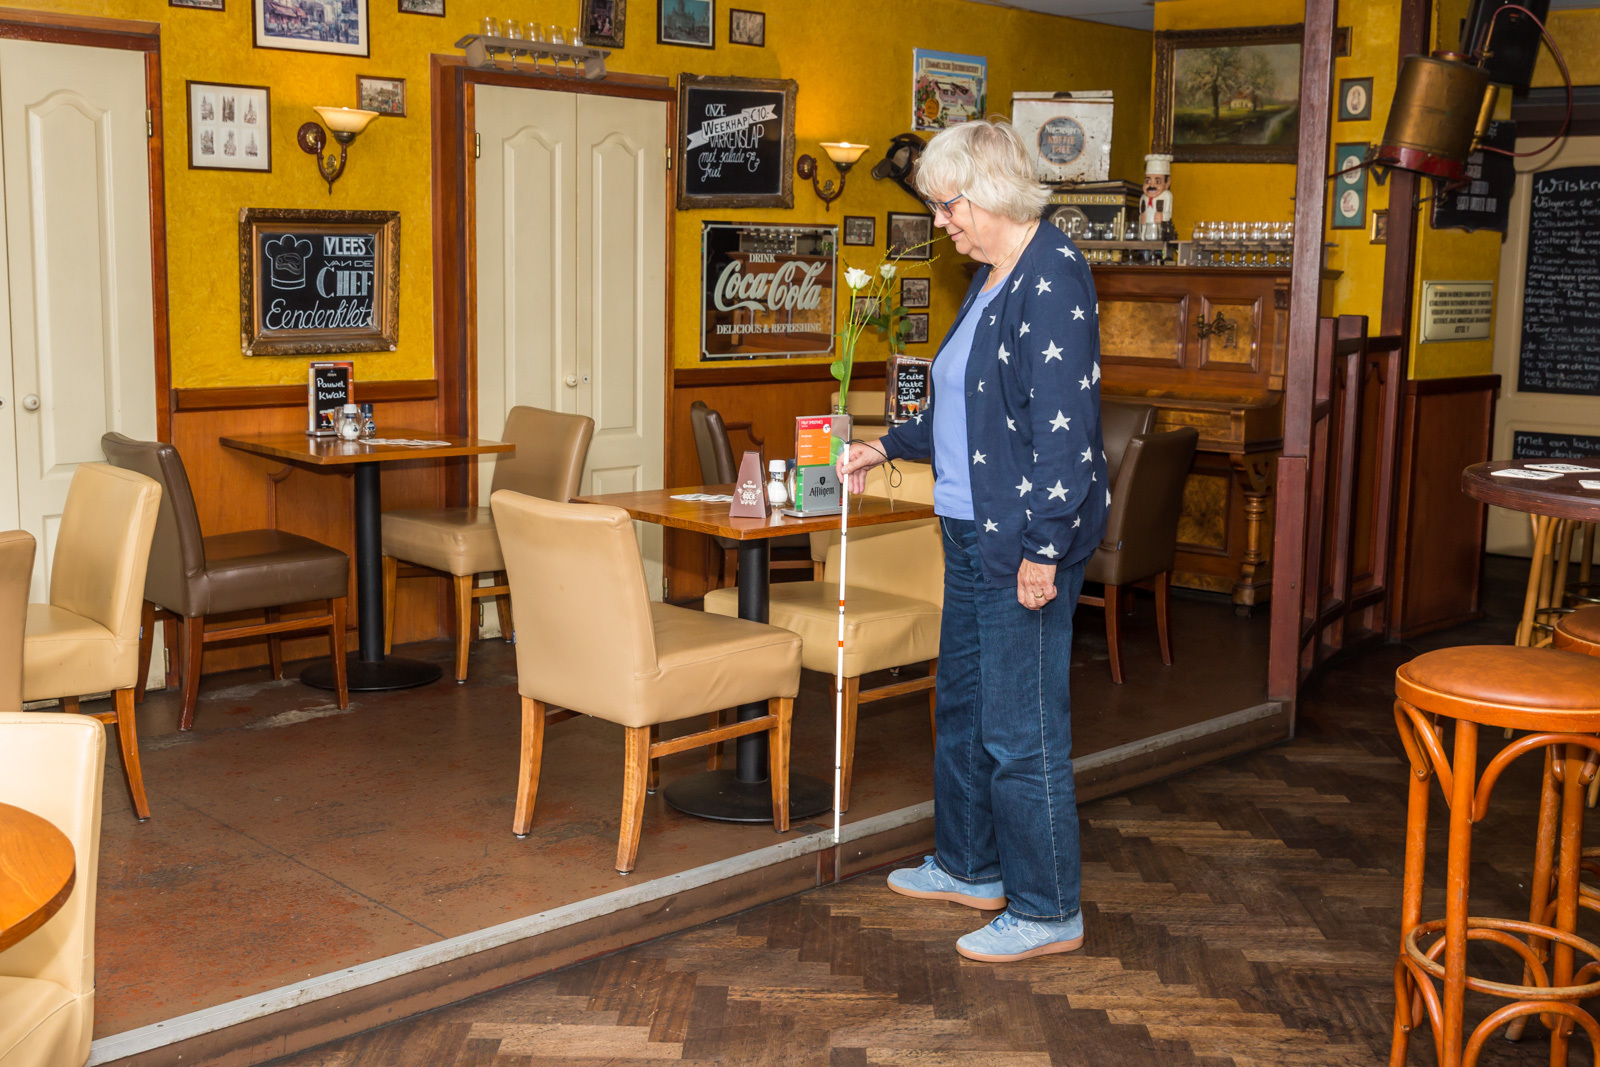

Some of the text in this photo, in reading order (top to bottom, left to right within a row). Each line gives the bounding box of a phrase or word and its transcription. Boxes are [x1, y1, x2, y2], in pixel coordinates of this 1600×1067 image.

[705, 103, 727, 117] ONZE
[703, 116, 748, 136] WEEKHAP
[709, 124, 765, 149] VARKENSLAP
[1048, 135, 1075, 145] KOFFIE
[699, 148, 717, 163] met
[719, 148, 745, 163] salade
[1051, 145, 1071, 154] THEE
[698, 163, 722, 183] friet
[1067, 194, 1117, 203] EGBERTS
[1533, 195, 1594, 211] Volgens de
[325, 237, 367, 256] VLEES
[324, 260, 374, 268] VAN DE
[749, 254, 776, 263] DRINK
[316, 266, 374, 299] CHEF
[714, 260, 827, 311] Coca-Cola
[266, 298, 372, 330] Eendenfilet
[716, 322, 822, 335] DELICIOUS & REFRESHING
[316, 377, 346, 388] Pauwel
[901, 387, 921, 396] IPA
[1516, 435, 1544, 446] Met
[1549, 440, 1568, 448] een
[1573, 438, 1595, 450] lach
[1517, 445, 1547, 457] traan
[809, 486, 835, 497] Affligem
[1017, 921, 1050, 946] N
